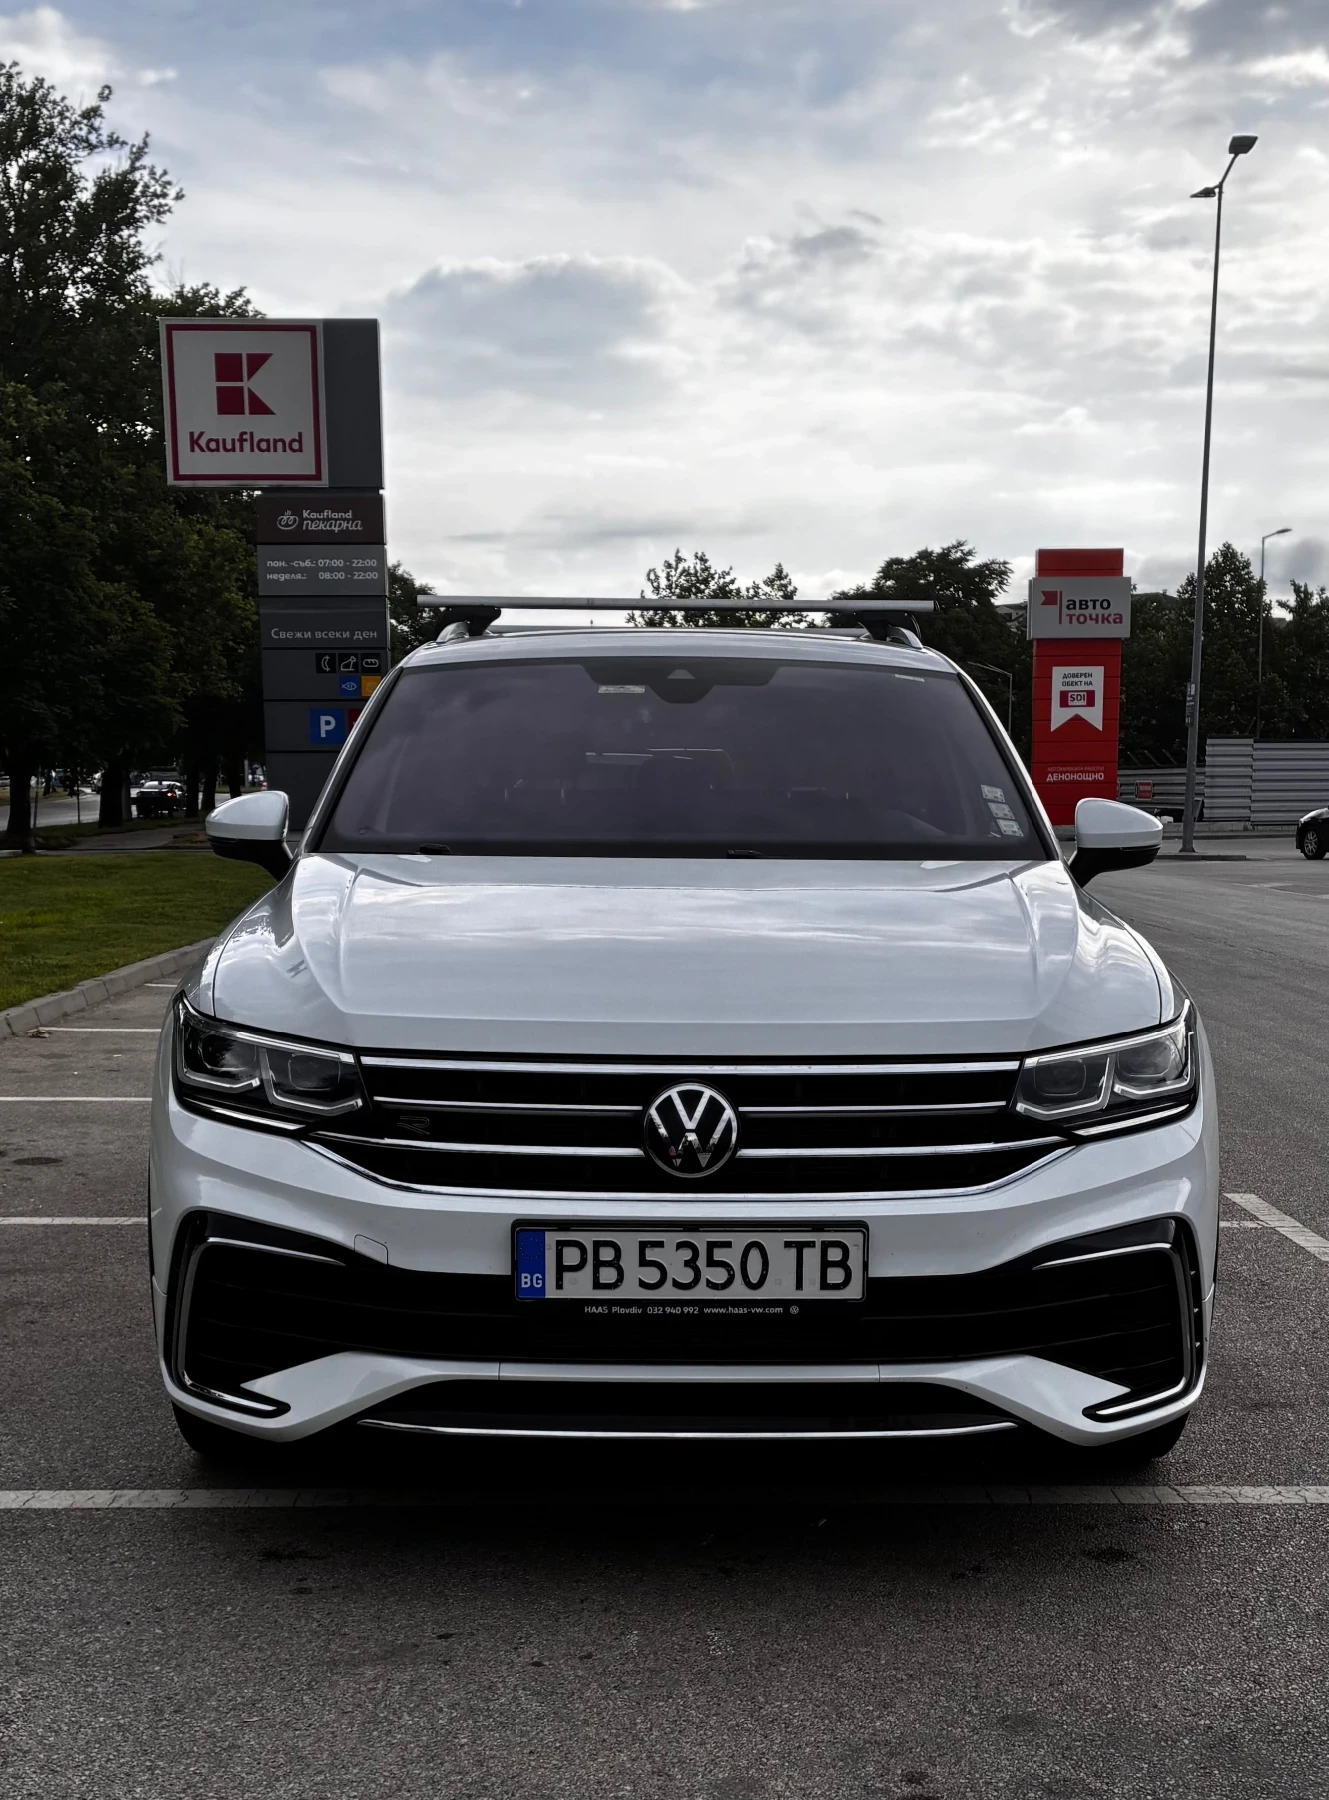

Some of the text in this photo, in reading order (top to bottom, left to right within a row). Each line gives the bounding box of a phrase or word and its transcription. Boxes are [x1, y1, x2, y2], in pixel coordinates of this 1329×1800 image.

[189, 431, 303, 453] Kaufland
[302, 509, 352, 519] Kaufland
[302, 520, 363, 533] пекарна
[318, 559, 344, 567] 07:00
[352, 559, 377, 567] 22:00
[318, 571, 345, 580] 08:00
[353, 571, 378, 579] 22:00
[1066, 599, 1111, 611] авто
[1066, 613, 1123, 625] точка
[271, 628, 377, 640] Свежи всеки ден
[1069, 694, 1086, 702] SDI
[320, 715, 336, 737] P
[1046, 772, 1104, 782] ДЕНОНОЩНО
[555, 1239, 852, 1291] PB 5350 TB
[521, 1273, 543, 1288] BG
[585, 1305, 783, 1314] HAAS Plovdiv 032 940 992 www.haas-vw.com
